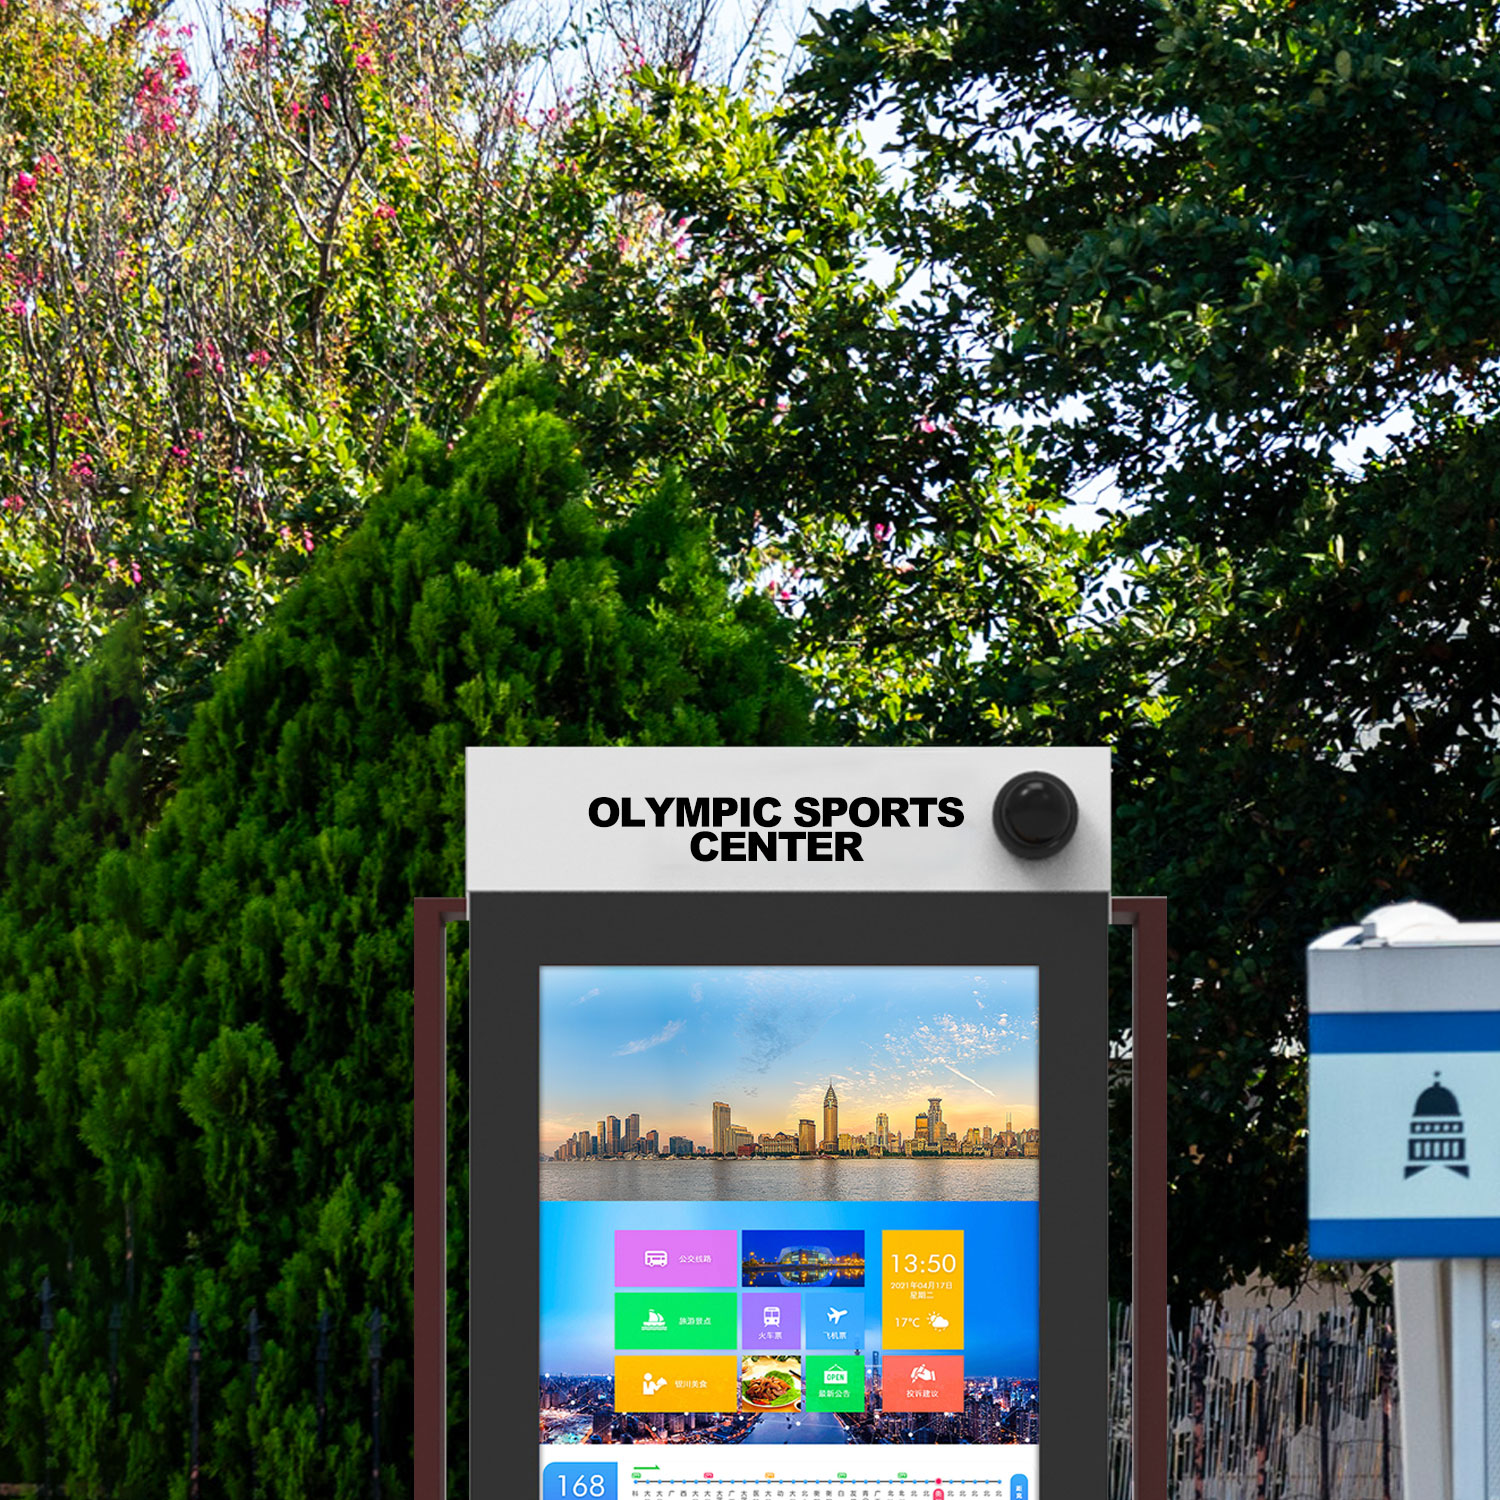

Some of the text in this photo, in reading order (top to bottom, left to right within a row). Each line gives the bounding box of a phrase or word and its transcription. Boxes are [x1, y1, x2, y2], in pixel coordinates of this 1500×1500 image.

[588, 796, 965, 828] OLYMPIC SPORTS
[690, 830, 865, 862] CENTER
[891, 1253, 956, 1273] 13:50
[890, 1281, 953, 1290] 2021年04月17日
[910, 1291, 934, 1300] 星期二
[758, 1331, 783, 1340] 火车票
[823, 1331, 848, 1340] 飞机票
[826, 1373, 845, 1381] OPEN
[818, 1389, 851, 1398] 最新公告
[906, 1389, 939, 1398] 投诉建议
[558, 1474, 605, 1497] 168
